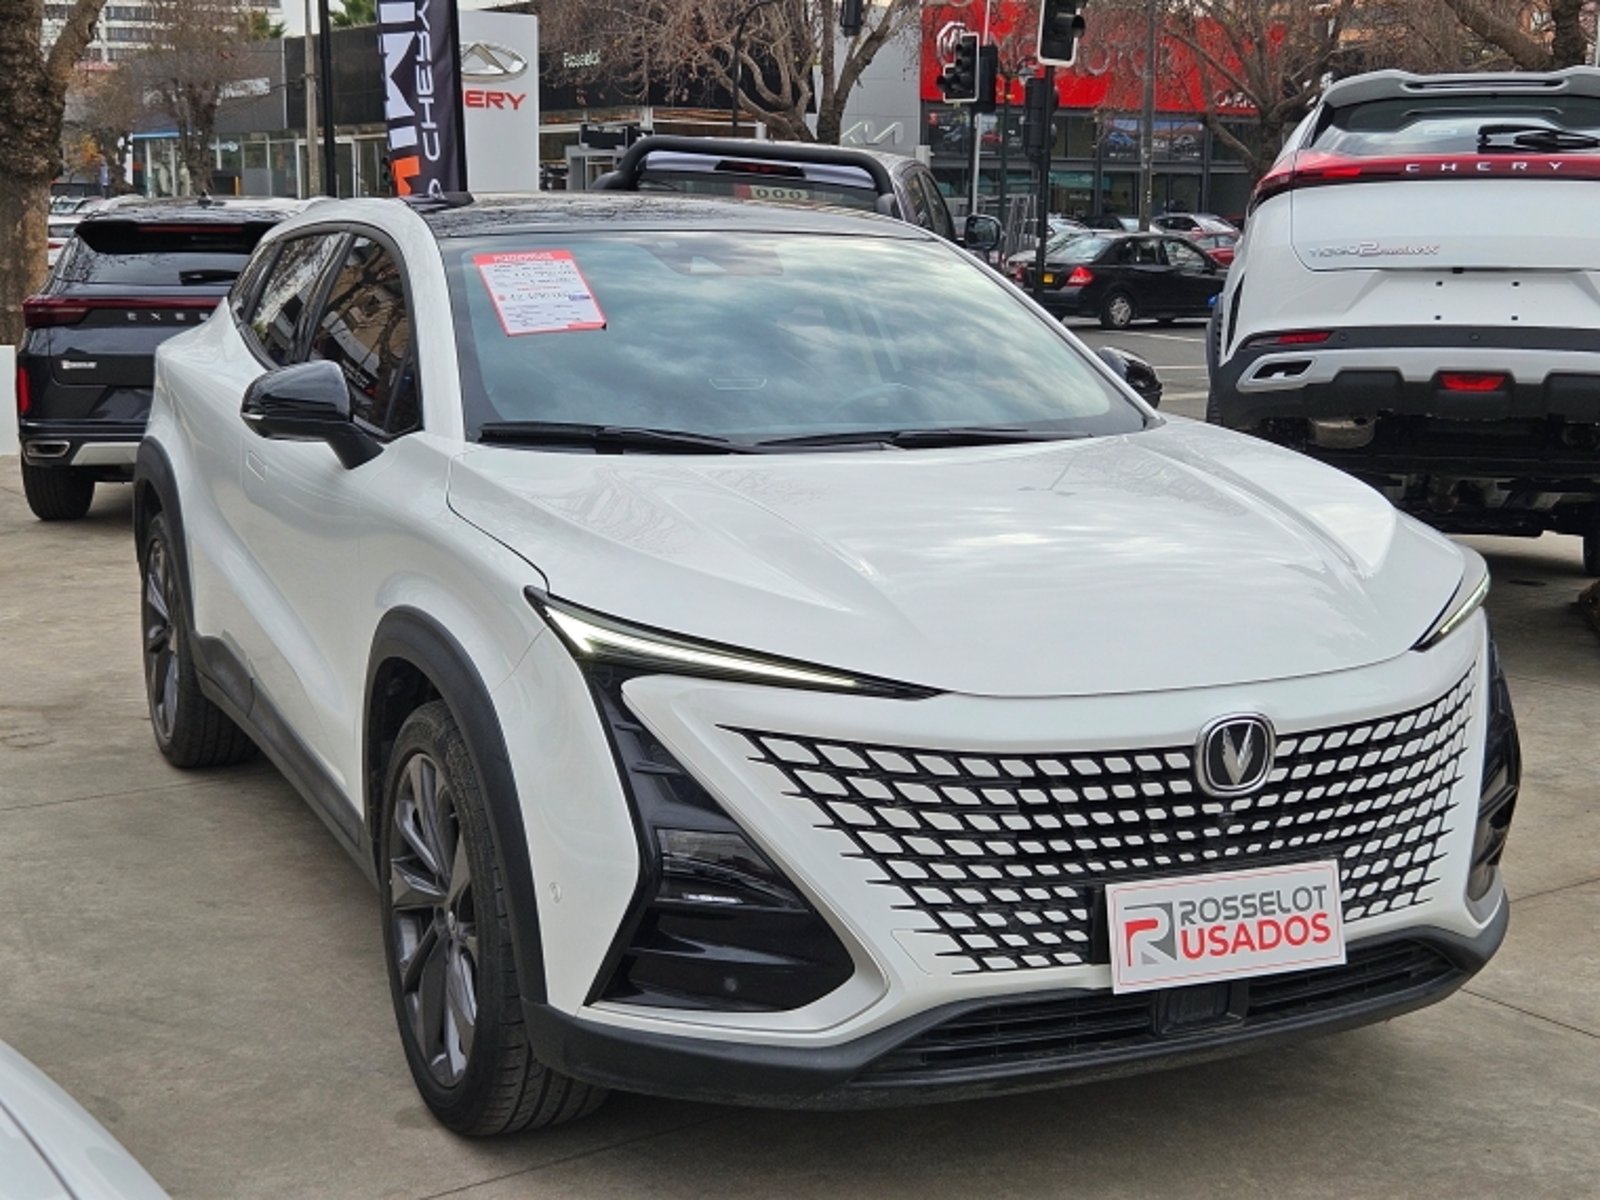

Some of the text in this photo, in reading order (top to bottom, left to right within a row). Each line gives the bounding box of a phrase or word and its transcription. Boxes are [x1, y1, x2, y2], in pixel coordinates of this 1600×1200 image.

[464, 89, 527, 111] ERY
[1405, 161, 1563, 172] CHERY
[1179, 885, 1328, 926] ROSSELOT
[1180, 912, 1332, 960] USADOS
